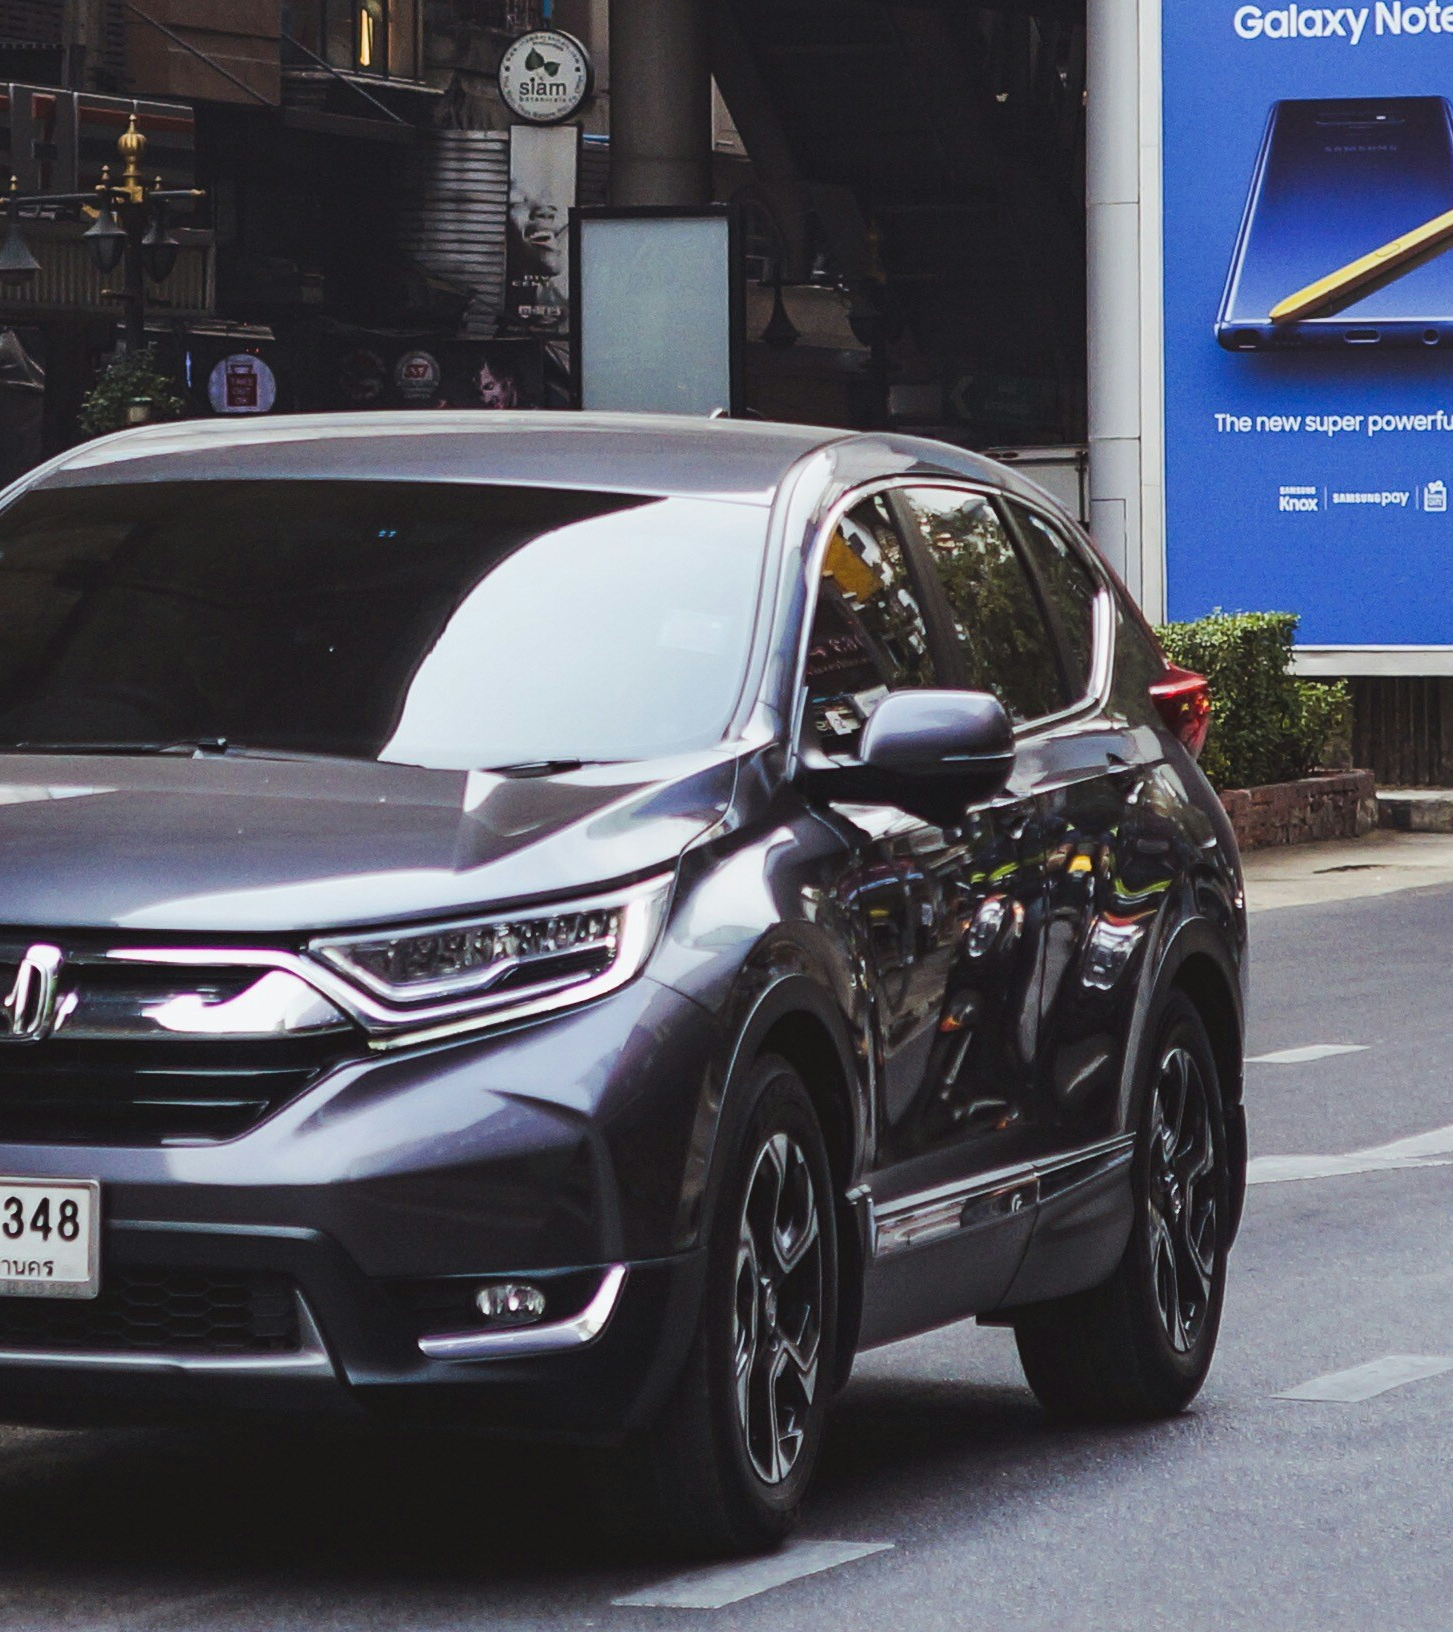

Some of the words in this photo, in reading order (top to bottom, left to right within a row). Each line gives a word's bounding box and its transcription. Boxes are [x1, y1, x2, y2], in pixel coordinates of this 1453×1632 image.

[1234, 4, 1368, 45] Galaxy
[519, 76, 566, 96] siam
[1214, 412, 1252, 433] The
[1256, 415, 1301, 432] new
[1305, 414, 1364, 436] super
[1279, 486, 1316, 495] SAMSUNG
[1333, 492, 1381, 504] SAMSUNG
[1381, 491, 1409, 507] pay
[1279, 496, 1318, 512] Knox
